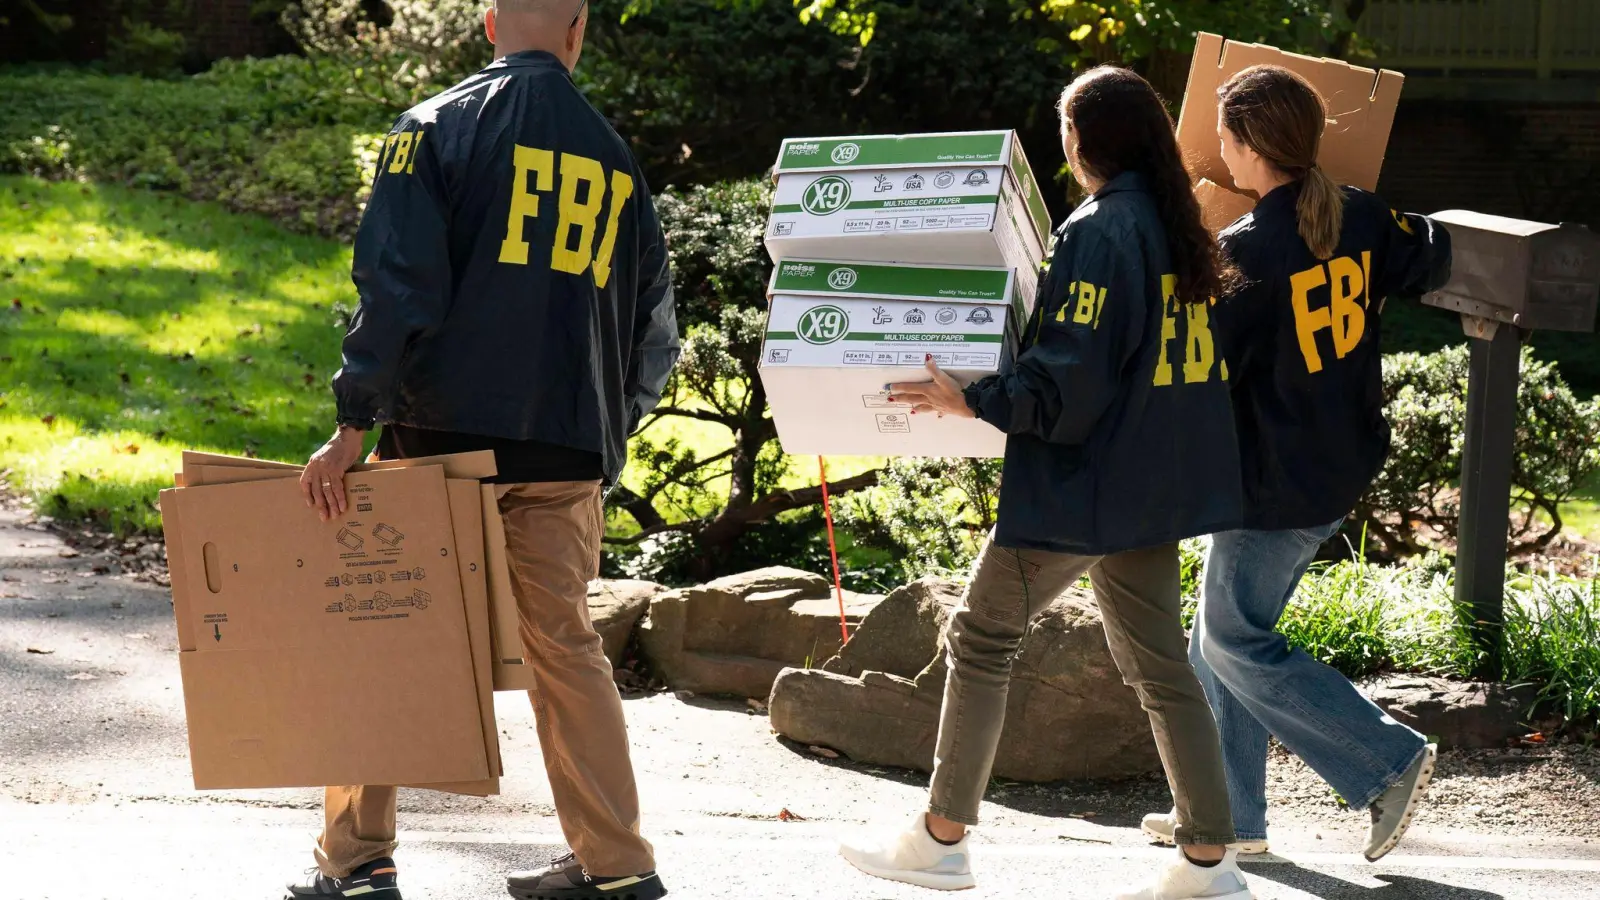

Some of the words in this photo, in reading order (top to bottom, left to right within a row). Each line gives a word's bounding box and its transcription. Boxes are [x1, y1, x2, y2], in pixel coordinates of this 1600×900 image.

[382, 130, 425, 175] FBI
[905, 182, 922, 190] USA
[919, 198, 938, 206] COPY
[938, 197, 961, 205] PAPER
[498, 143, 634, 289] FBI
[905, 316, 922, 324] USA
[1289, 250, 1371, 374] FBI
[883, 333, 920, 341] MULTI-USE
[1152, 273, 1229, 386] FB
